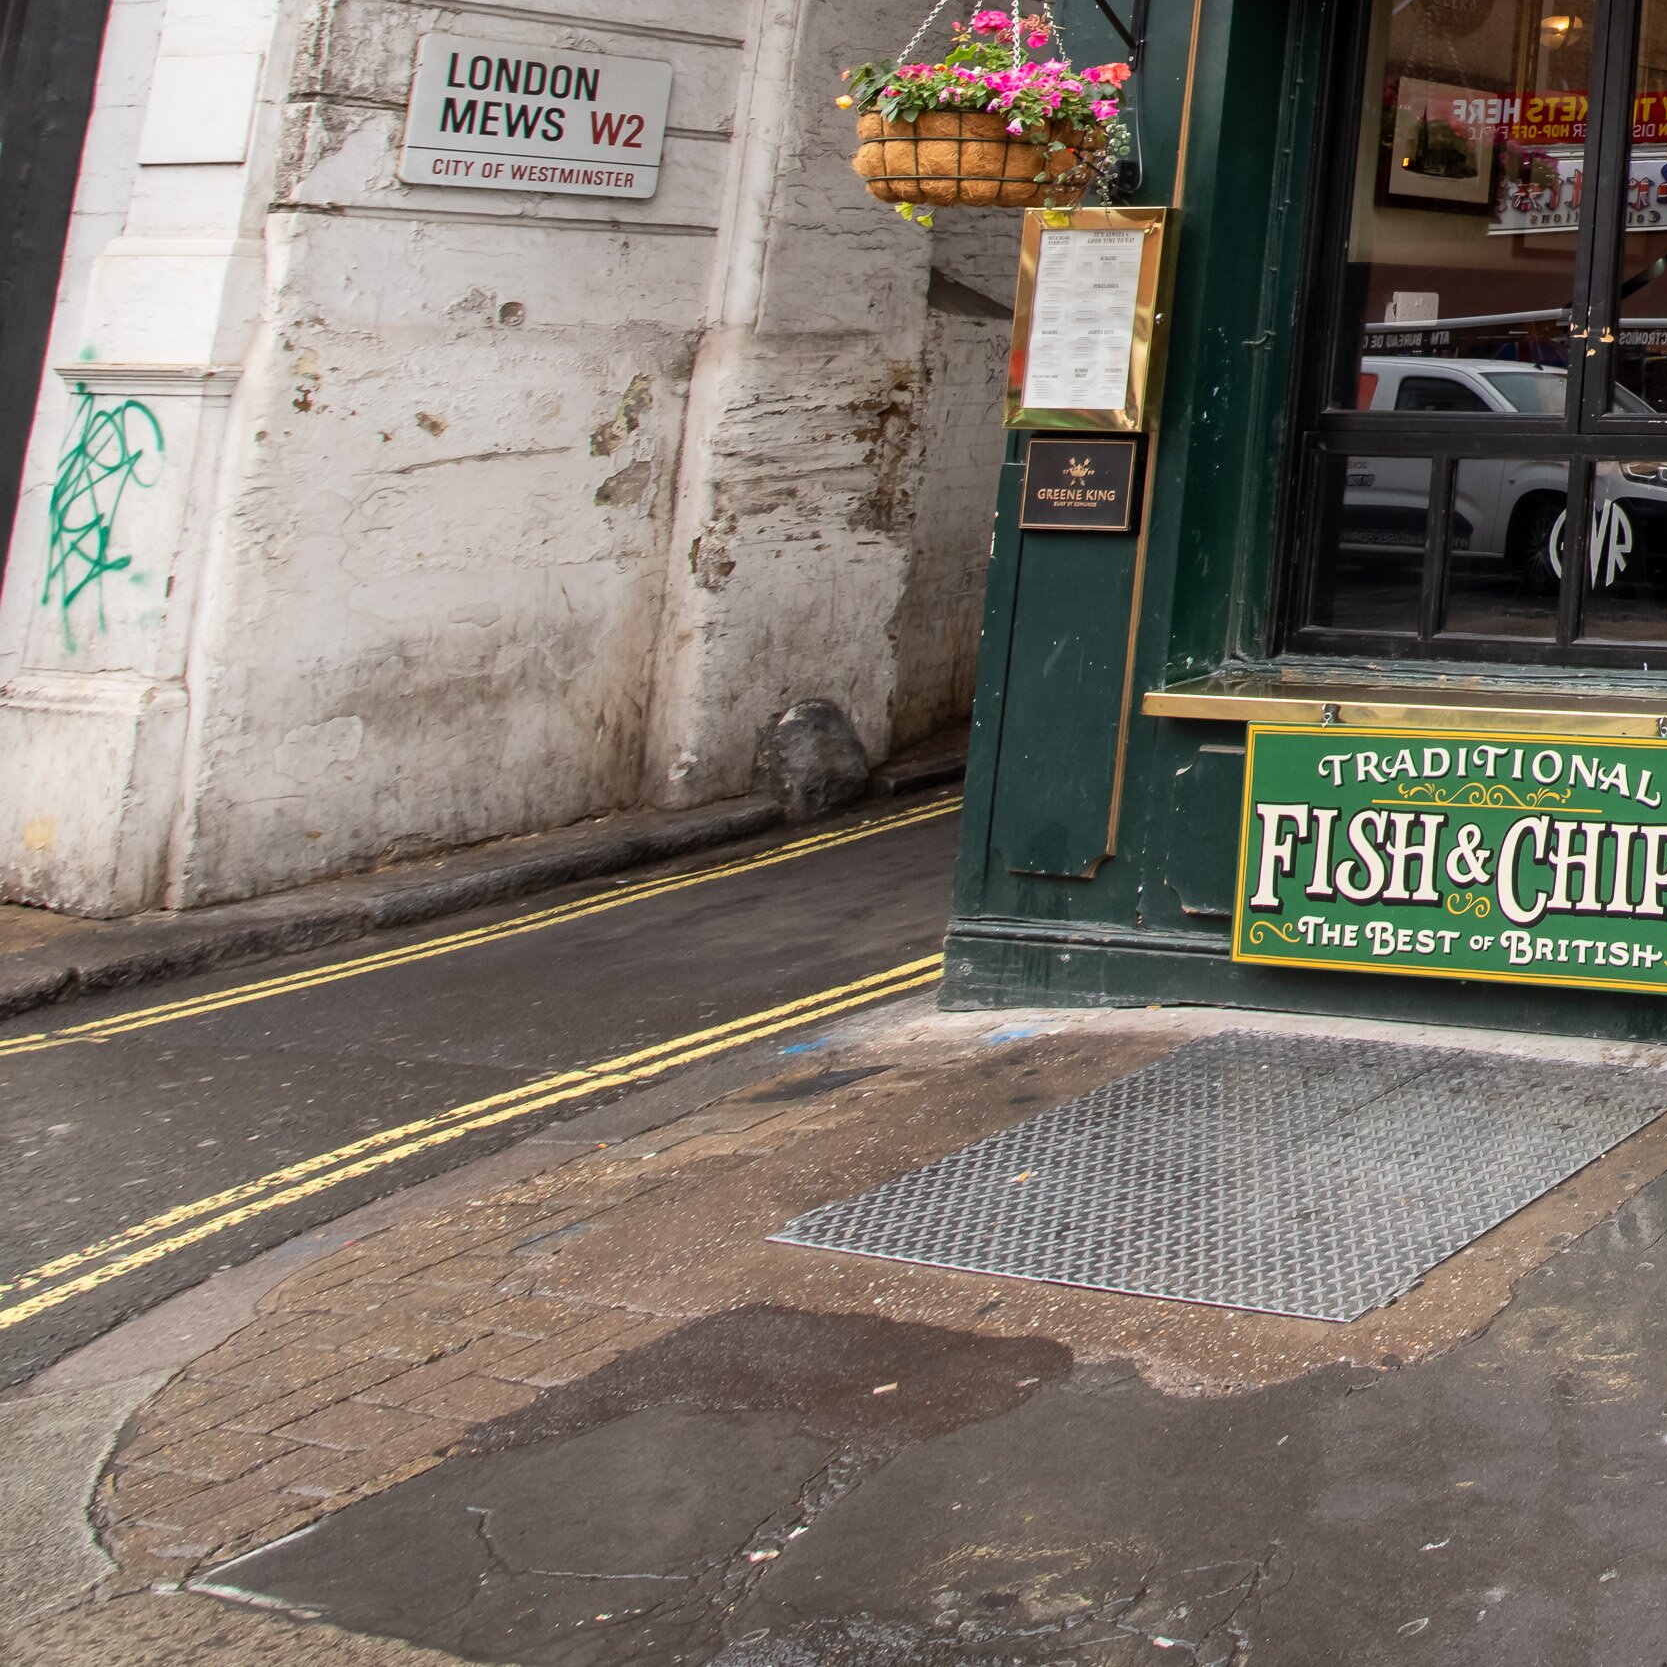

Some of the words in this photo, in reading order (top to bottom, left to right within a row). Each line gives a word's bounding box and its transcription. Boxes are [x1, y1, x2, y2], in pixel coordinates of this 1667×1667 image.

[445, 52, 600, 102] LONDON
[439, 96, 566, 142] MEWS
[590, 110, 645, 148] W2
[432, 158, 475, 178] CITY
[481, 162, 504, 179] OF
[510, 165, 635, 188] WESTMINSTER
[1037, 488, 1083, 500] GREENE
[1086, 489, 1116, 501] KING
[1318, 745, 1662, 808] TRADITIONAL
[1249, 801, 1447, 910] FISH
[1446, 823, 1495, 886] &
[1298, 915, 1358, 948] THE
[1364, 920, 1461, 957] BEST
[1470, 934, 1495, 951] OF
[1500, 929, 1663, 969] BRITISH
